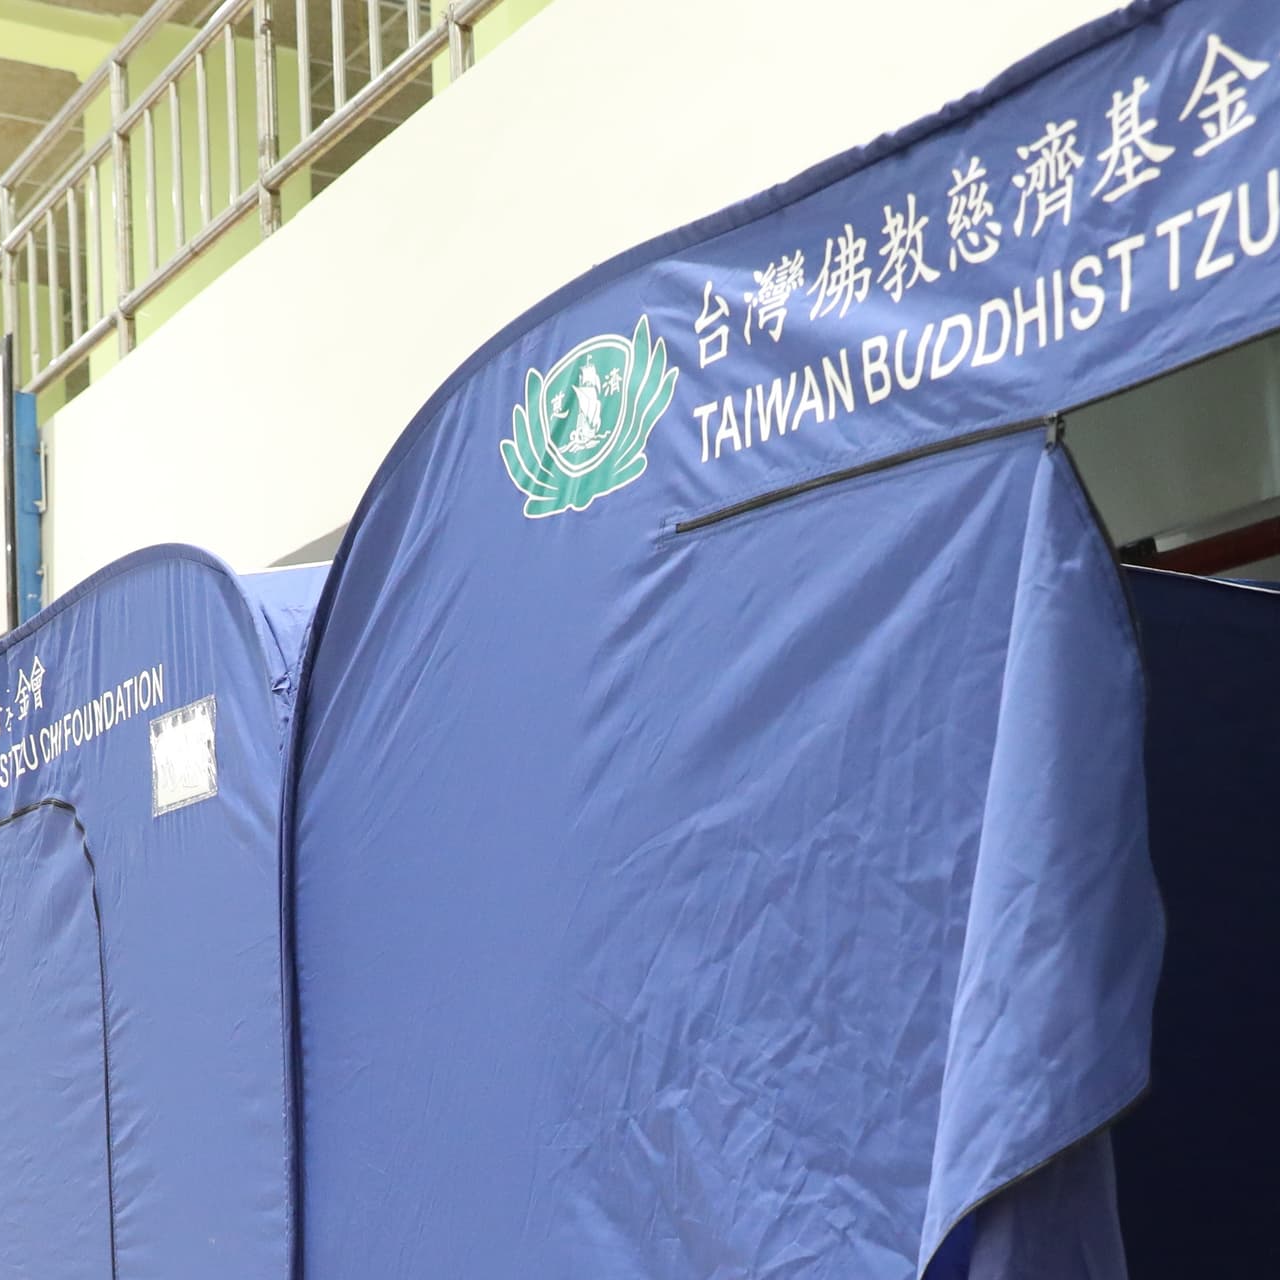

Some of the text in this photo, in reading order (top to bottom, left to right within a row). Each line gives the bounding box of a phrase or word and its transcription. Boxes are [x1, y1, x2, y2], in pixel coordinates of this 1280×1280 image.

[693, 348, 855, 463] TAIWAN
[862, 233, 1146, 405] BUDDHIST
[1156, 168, 1280, 291] TZU
[39, 719, 62, 764] CHI
[63, 663, 164, 752] FOUNDATION
